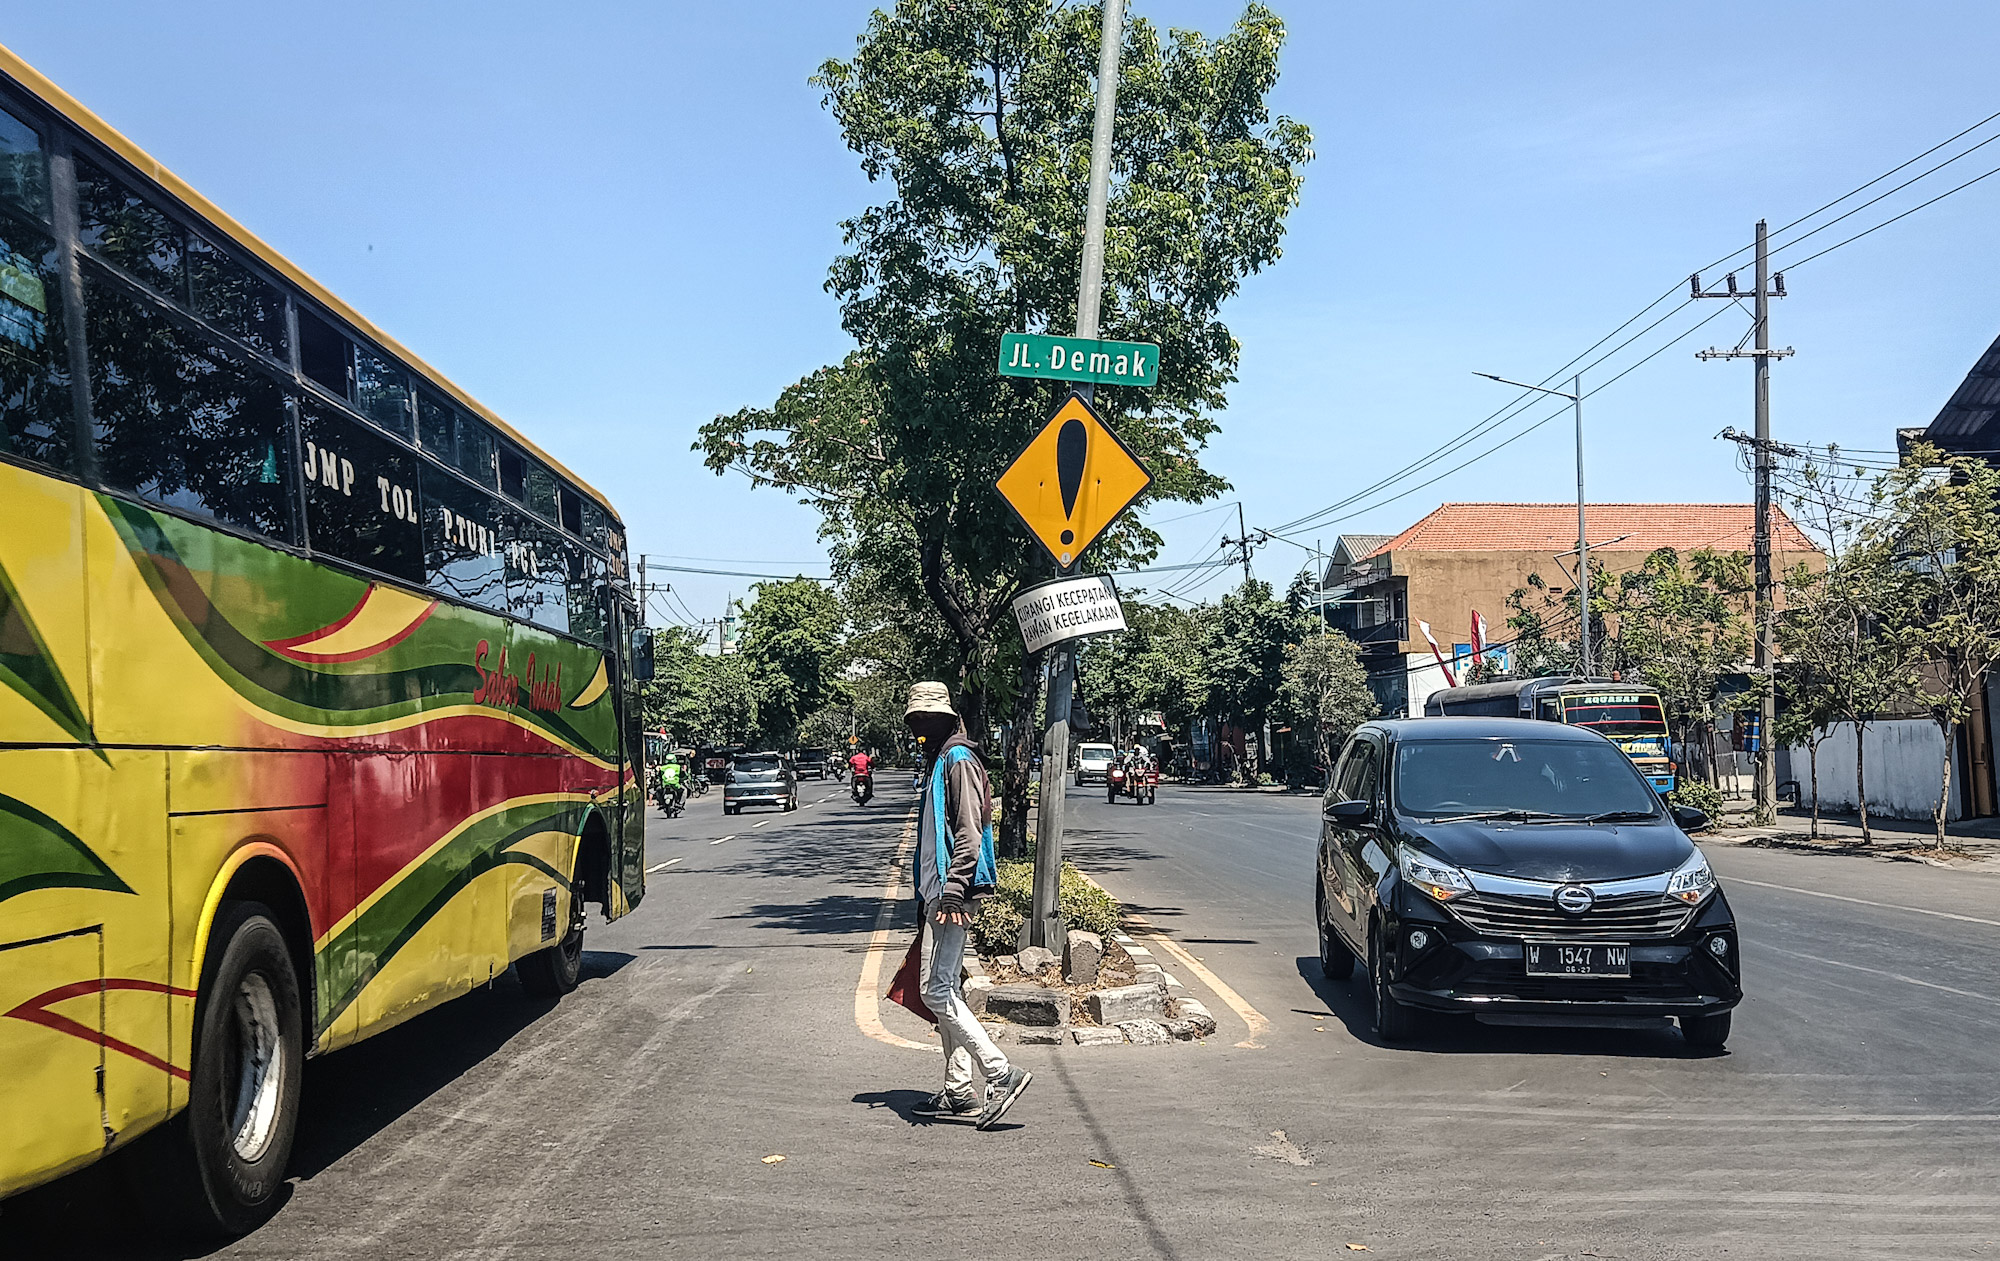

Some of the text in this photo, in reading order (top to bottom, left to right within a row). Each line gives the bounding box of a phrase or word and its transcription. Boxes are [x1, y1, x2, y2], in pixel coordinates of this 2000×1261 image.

[1008, 343, 1147, 377] JL. Demak
[304, 441, 355, 496] JMP
[377, 475, 417, 524] TOL
[1017, 585, 1113, 624] KURANGI KECEPATAN
[1023, 605, 1119, 644] RAWAN KECELAKAAN
[1529, 946, 1627, 966] W 1547 NW
